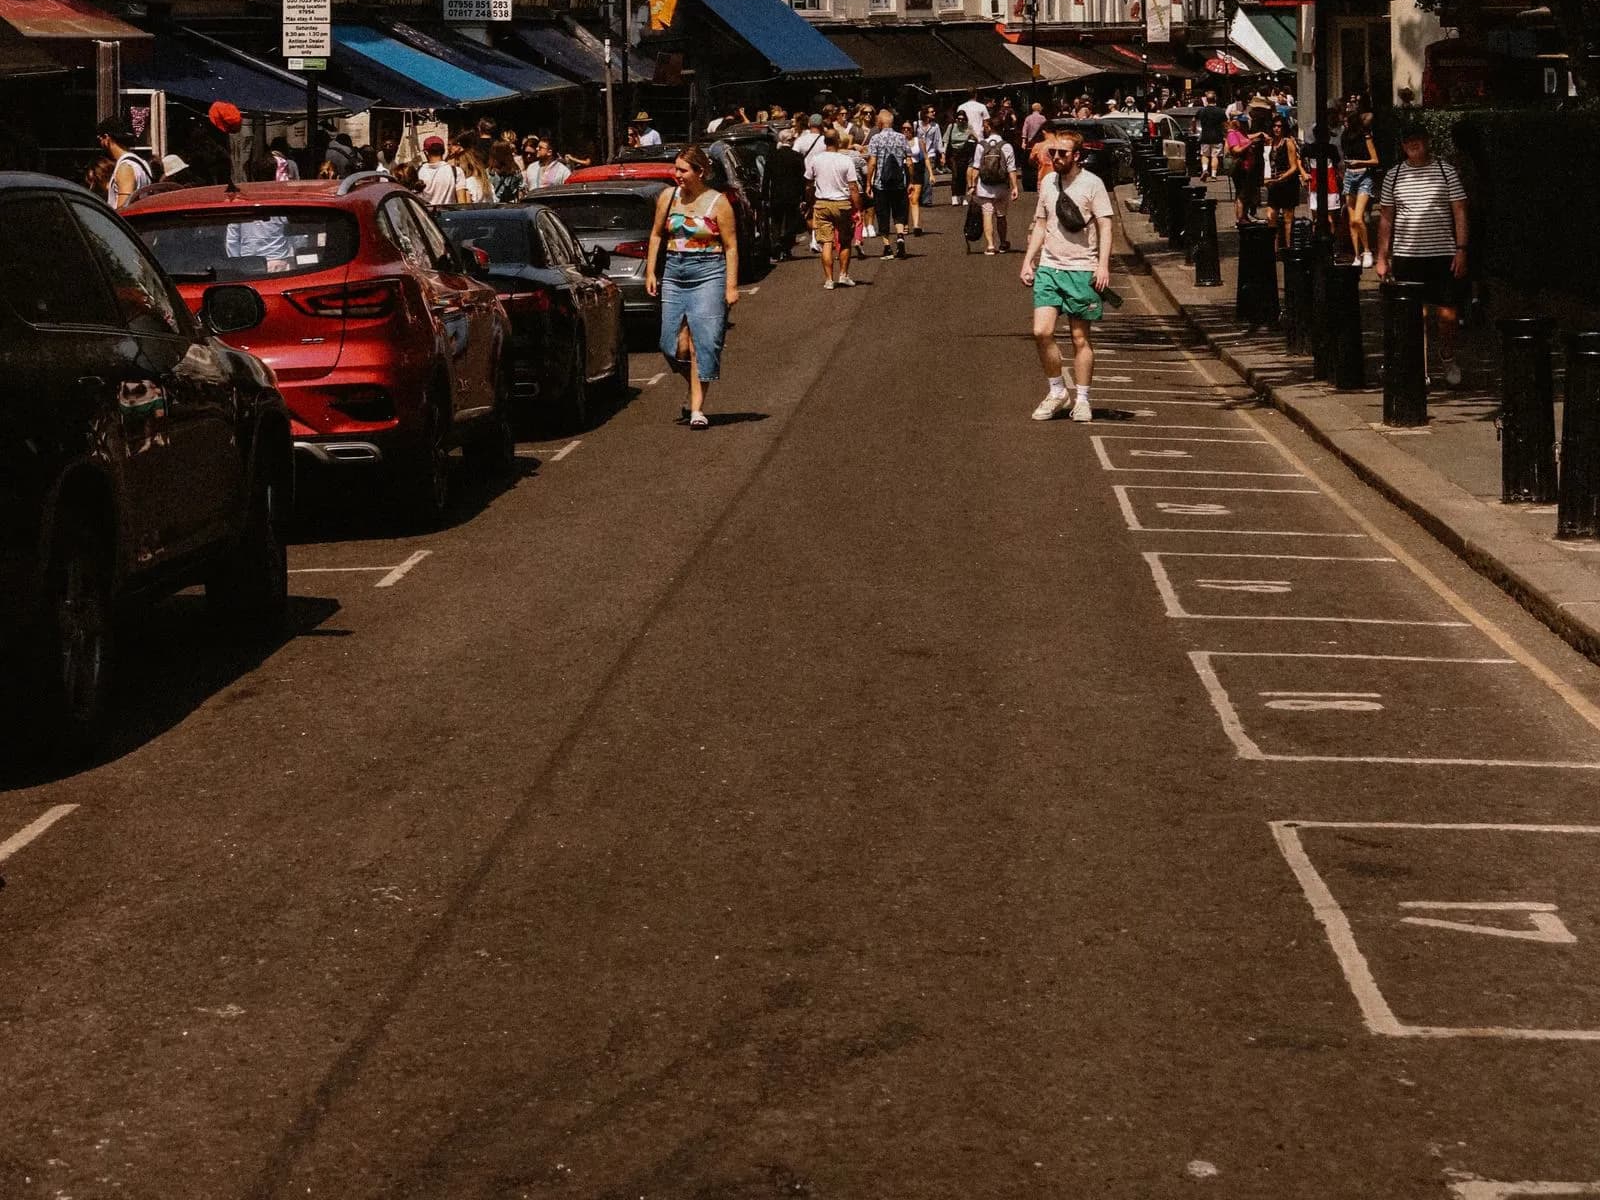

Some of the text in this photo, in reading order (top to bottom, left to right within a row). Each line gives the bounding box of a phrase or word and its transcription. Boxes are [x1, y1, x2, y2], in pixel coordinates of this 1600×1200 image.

[448, 0, 508, 9] 07956 851 283
[448, 9, 509, 18] 07817 248 538
[1258, 691, 1385, 712] 18
